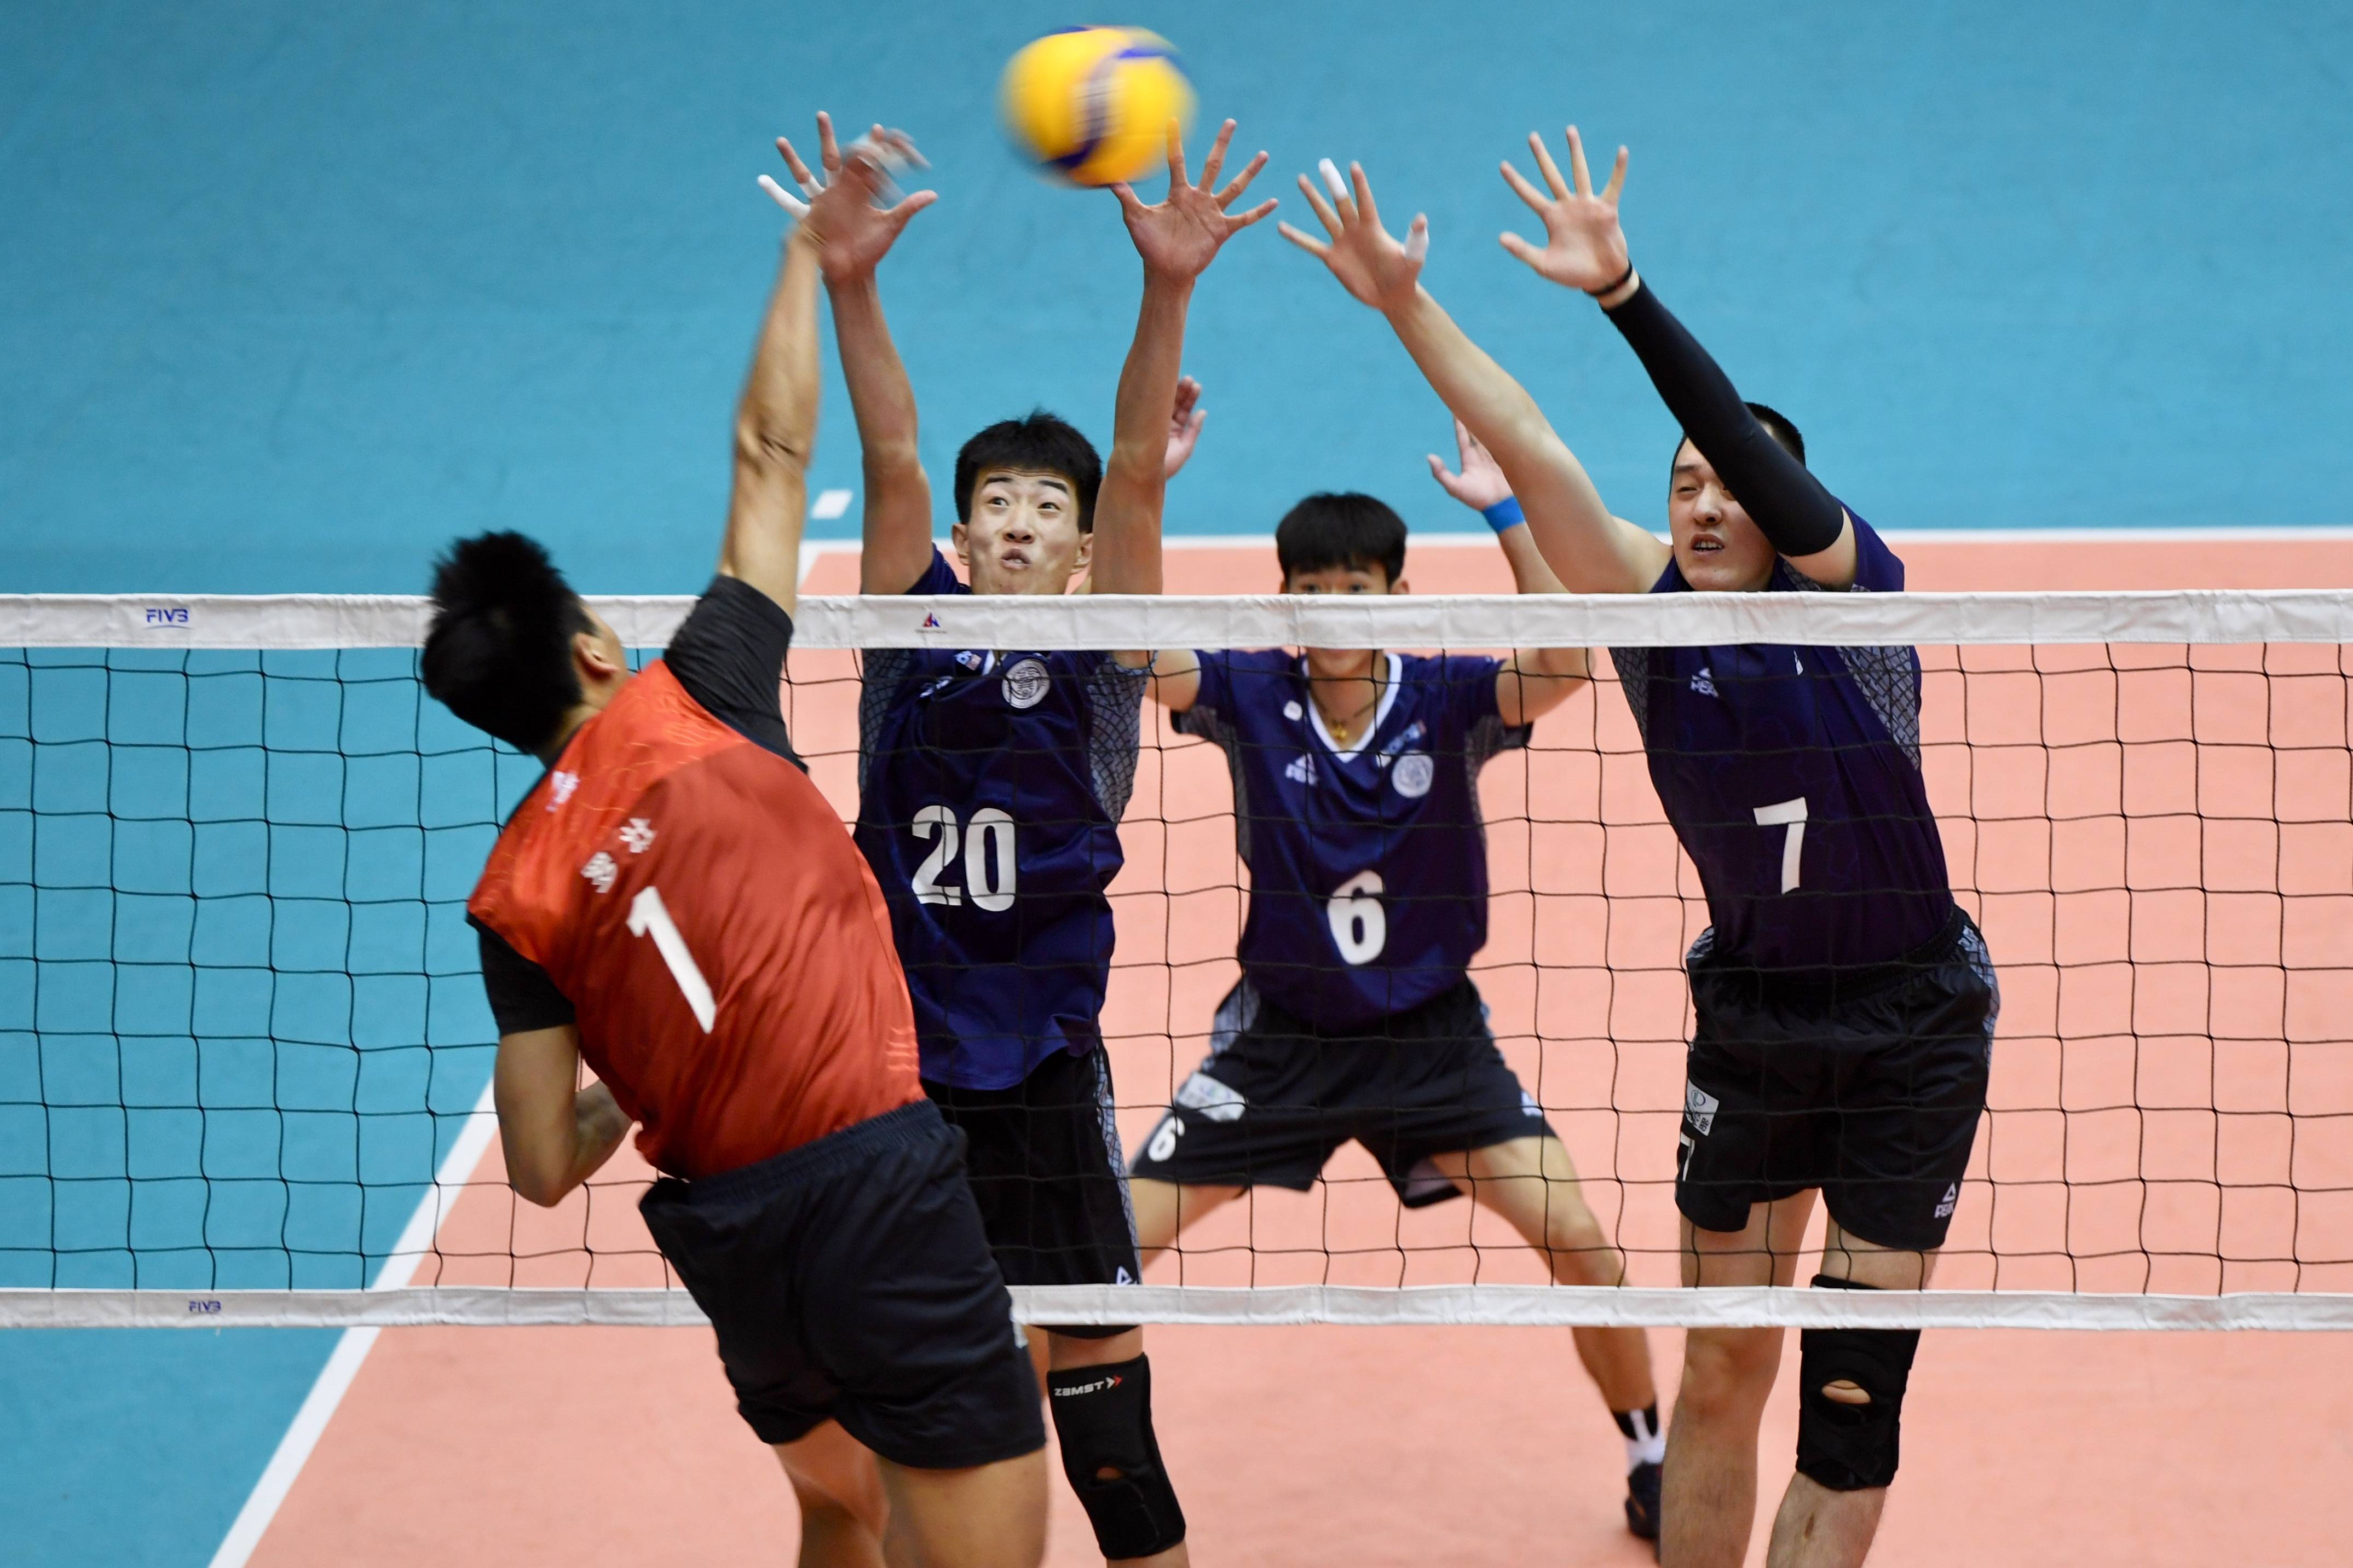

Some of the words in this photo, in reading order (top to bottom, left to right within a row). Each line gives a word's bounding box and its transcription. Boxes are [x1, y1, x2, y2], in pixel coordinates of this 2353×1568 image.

[146, 608, 189, 623] FIVB
[912, 805, 1016, 912] 20
[1753, 797, 1808, 895] 7
[626, 886, 717, 1034] 1
[1327, 869, 1386, 965] 6
[1148, 1116, 1185, 1161] 6
